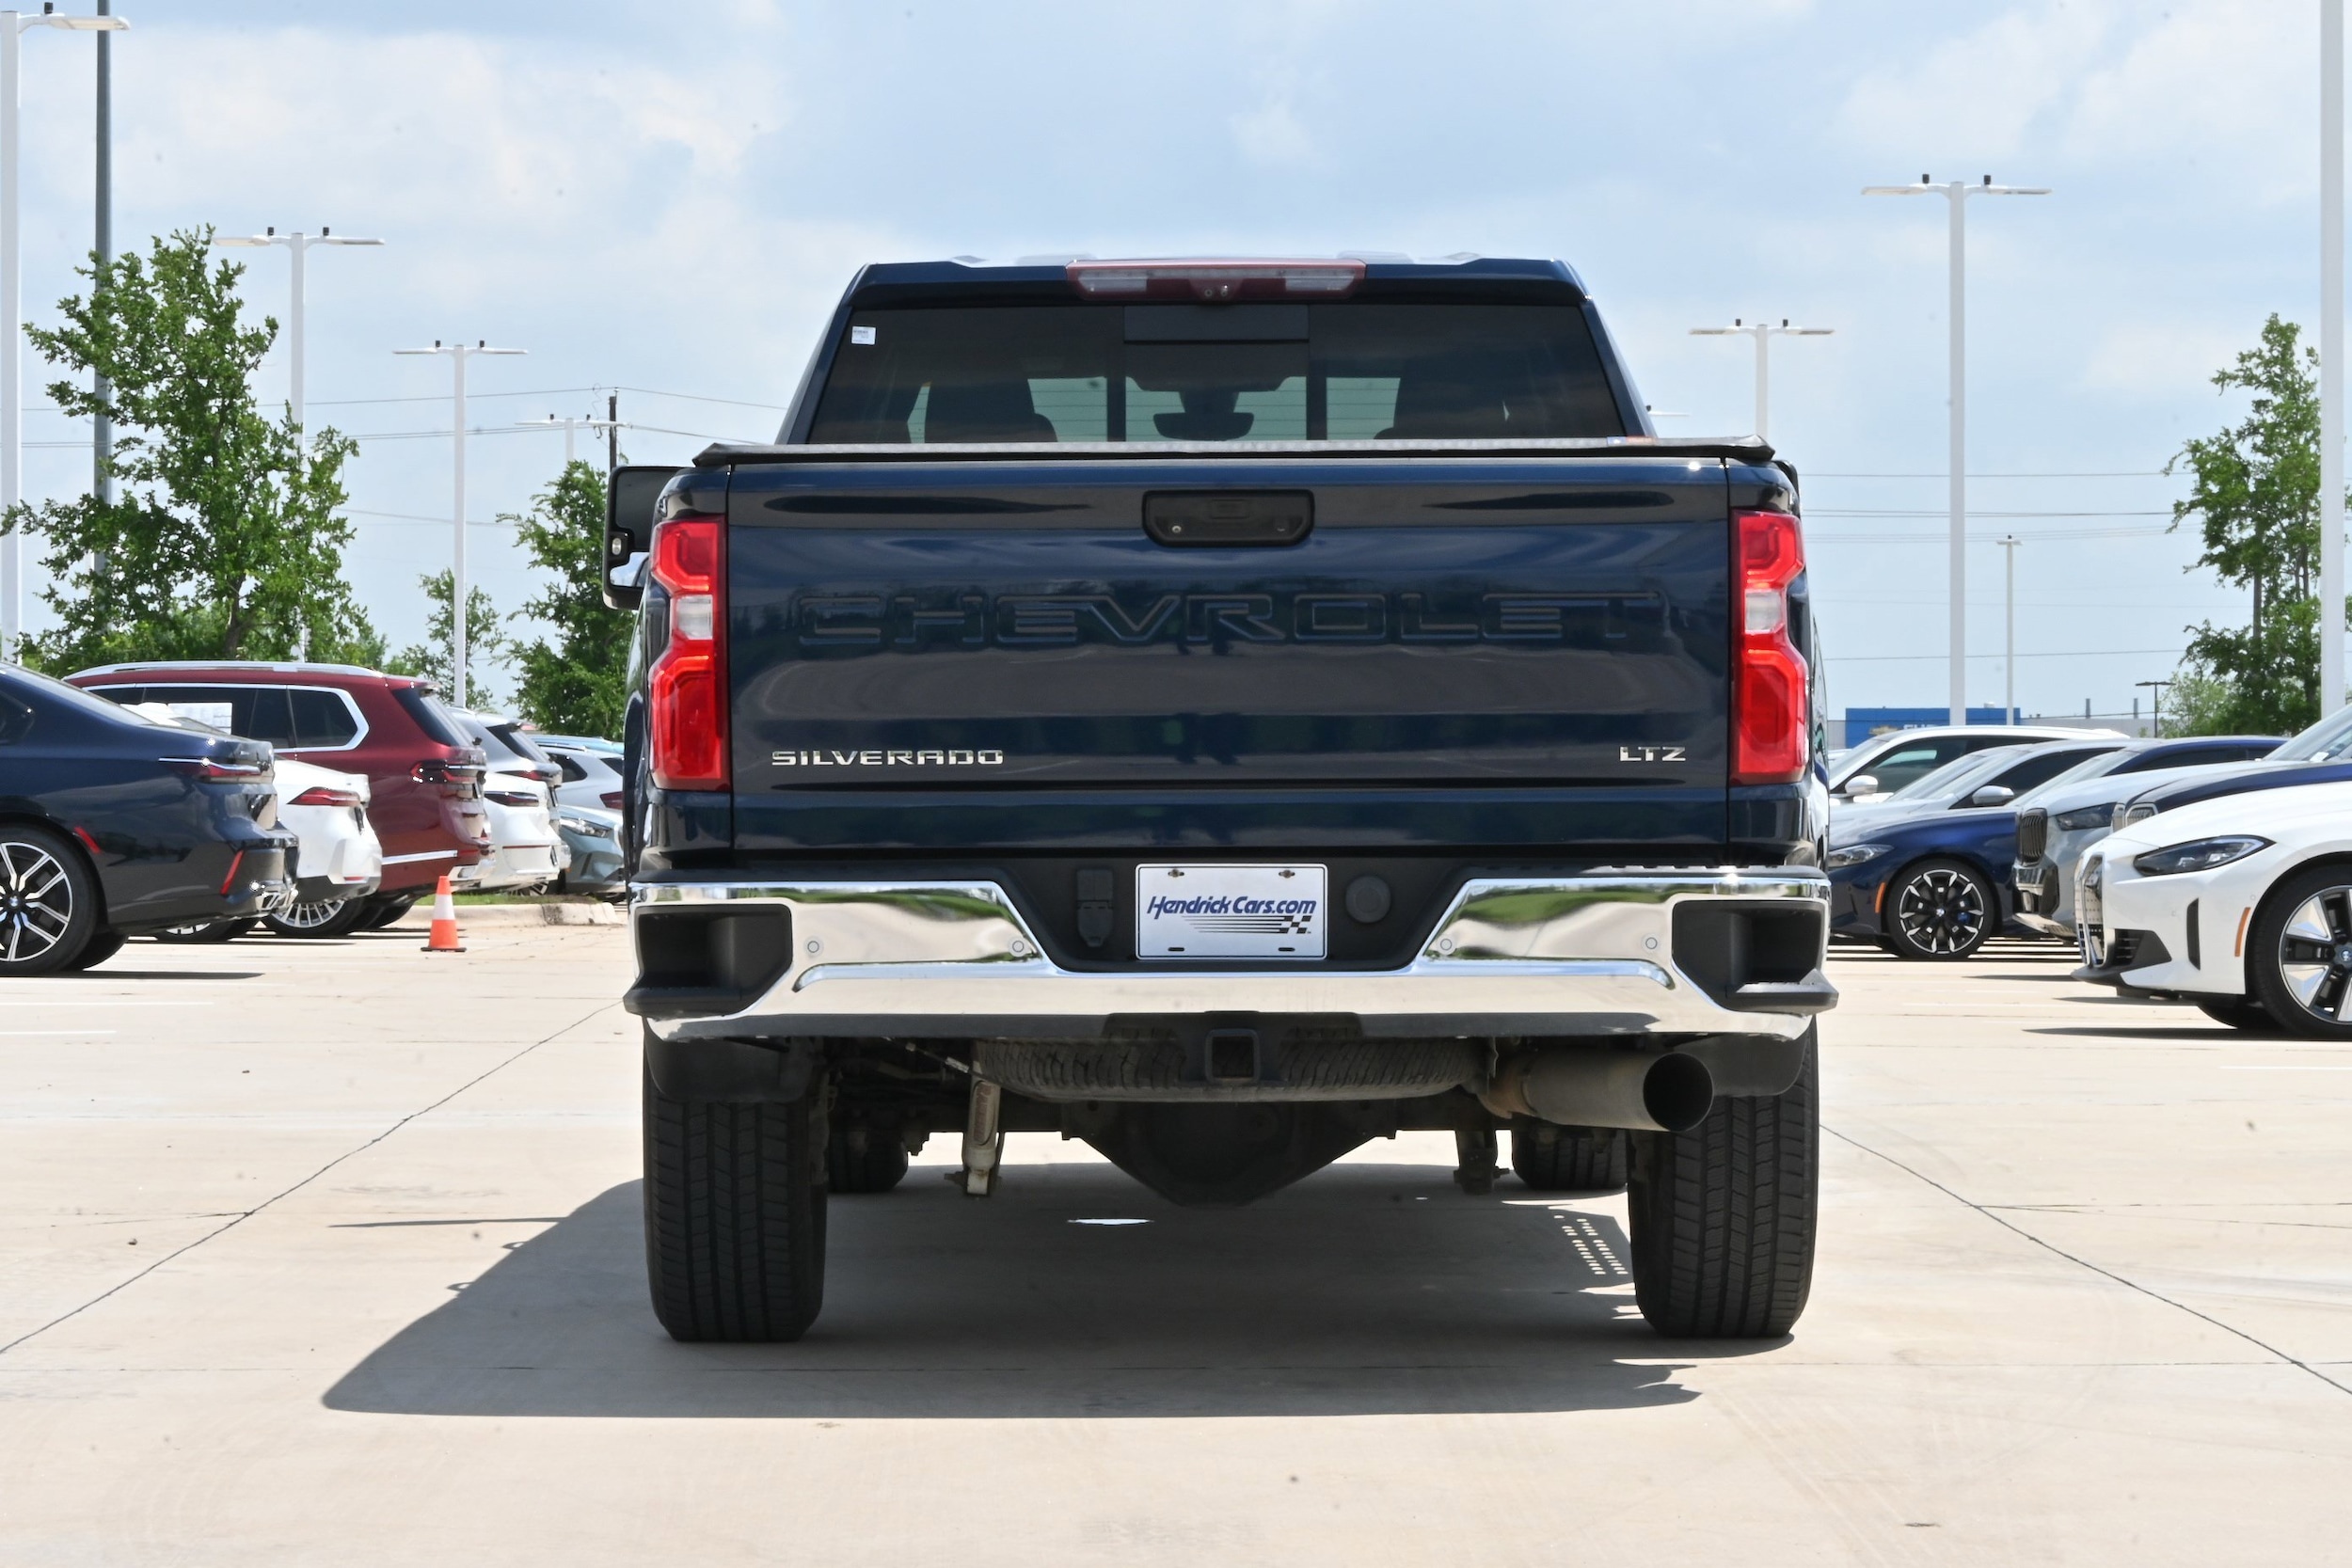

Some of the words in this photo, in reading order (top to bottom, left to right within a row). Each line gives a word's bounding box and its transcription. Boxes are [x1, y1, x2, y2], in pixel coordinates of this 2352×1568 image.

[797, 592, 1662, 645] CHEVROLET
[771, 750, 1004, 766] SILVERADO
[1619, 746, 1686, 761] LTZ
